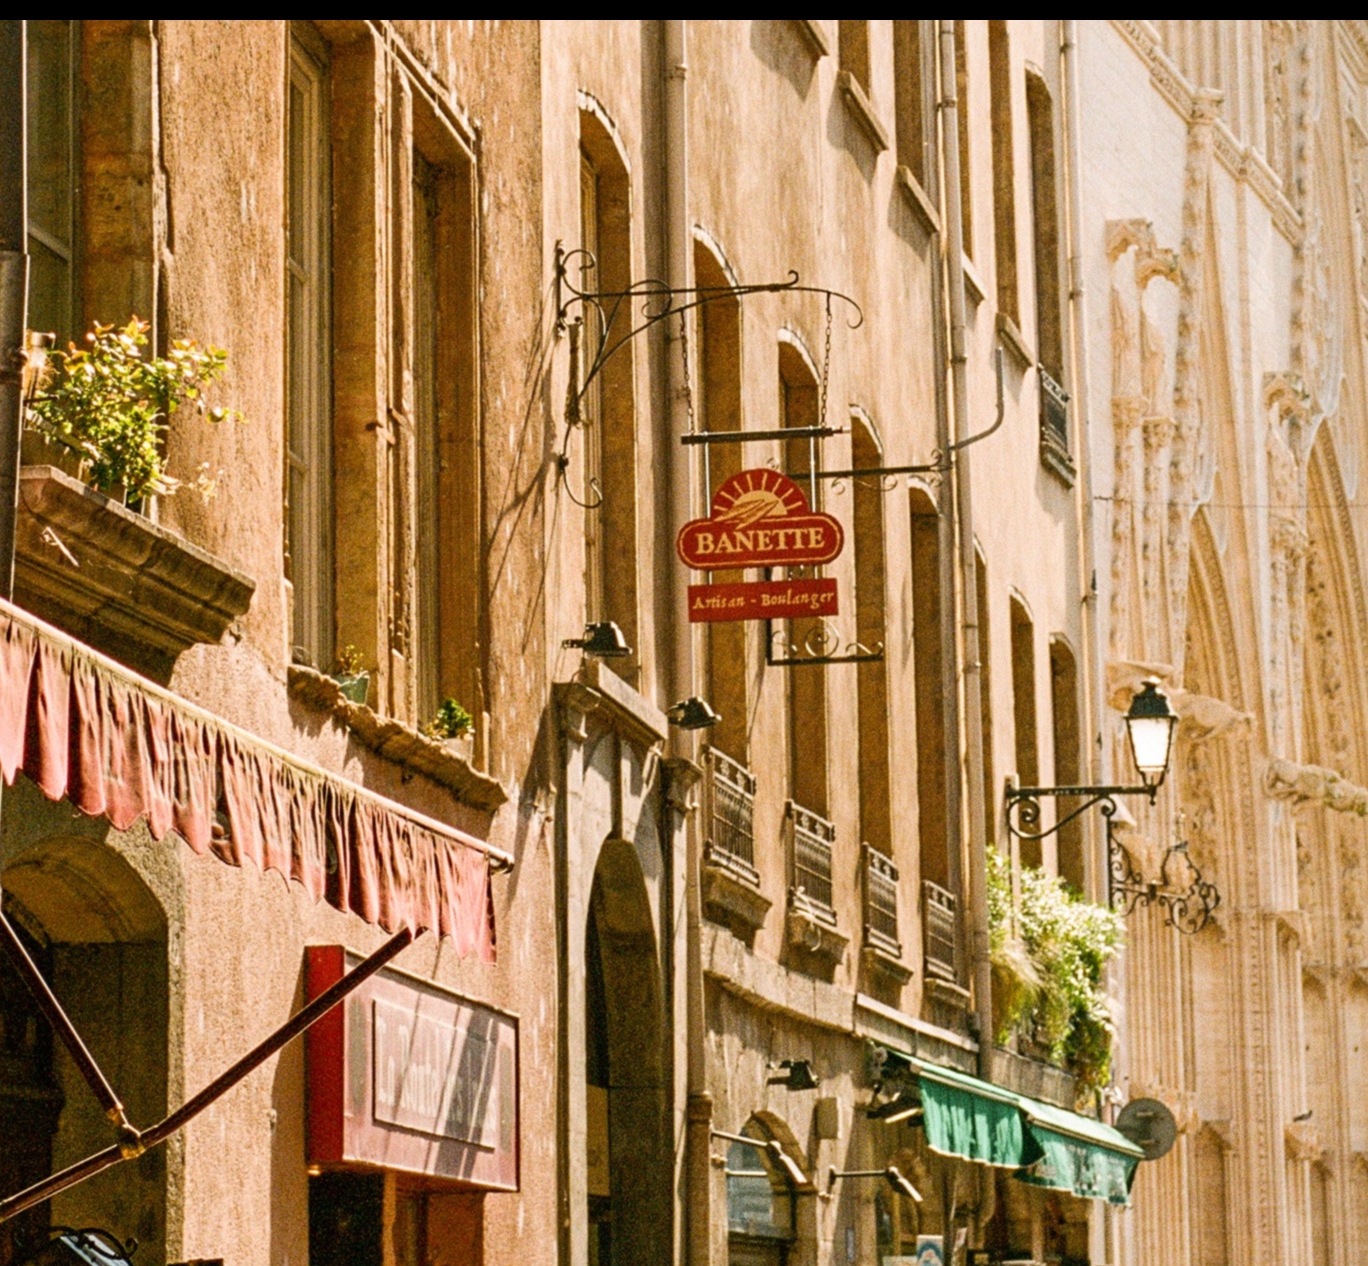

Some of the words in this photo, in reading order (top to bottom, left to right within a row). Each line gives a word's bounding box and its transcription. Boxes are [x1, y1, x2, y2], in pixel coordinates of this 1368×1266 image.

[695, 527, 826, 555] BANETTE
[693, 594, 746, 610] Artisan
[761, 588, 835, 610] Boulanger
